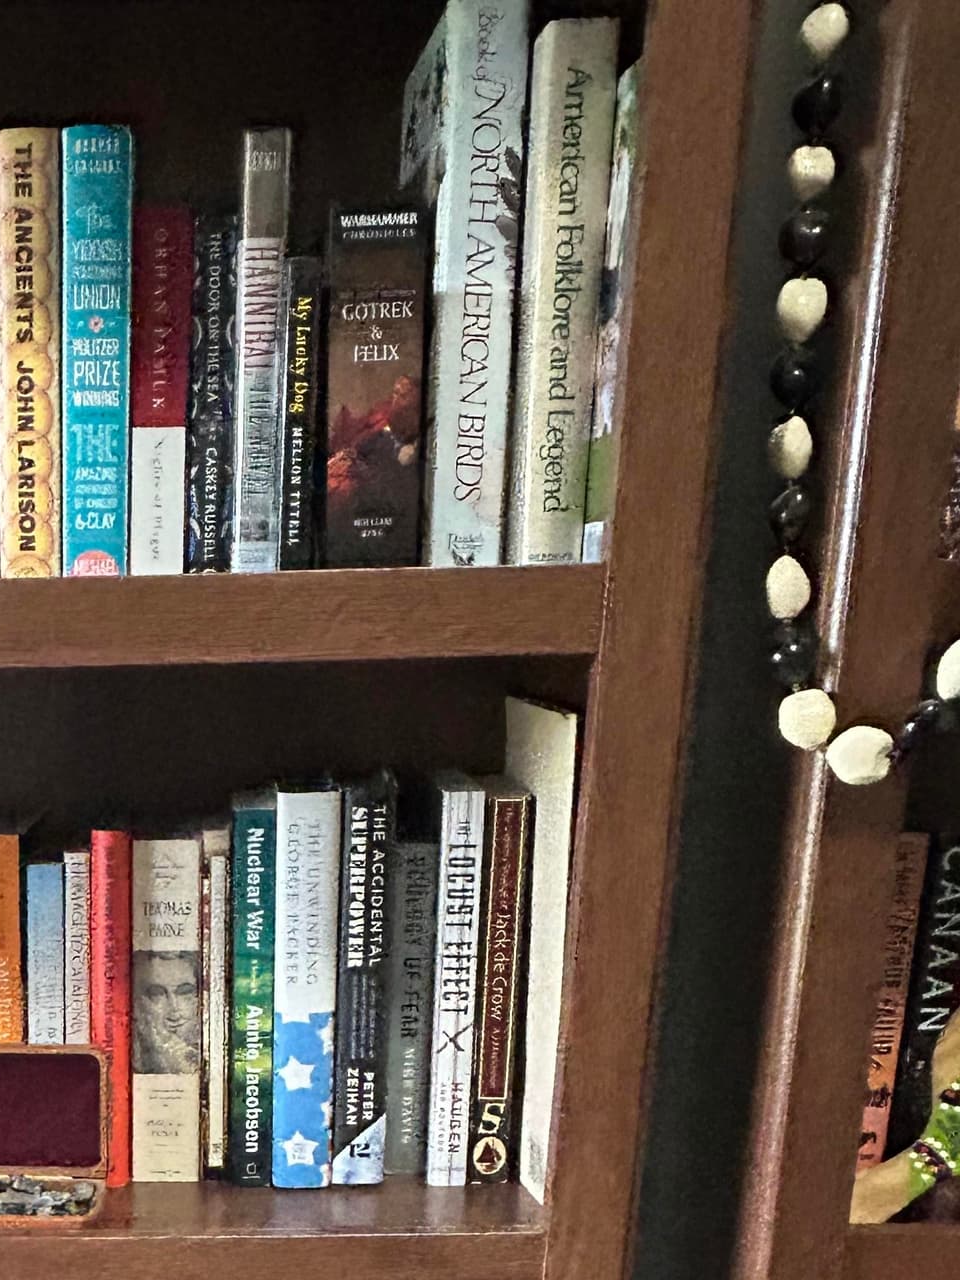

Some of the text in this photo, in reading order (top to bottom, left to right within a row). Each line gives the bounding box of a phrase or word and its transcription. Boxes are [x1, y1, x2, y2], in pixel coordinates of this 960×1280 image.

[468, 84, 504, 225] NORTH
[340, 213, 418, 227] WARHAMMER
[73, 284, 121, 309] UNION
[207, 233, 222, 402] THE DOOR ON THE SEA
[243, 246, 279, 372] HANNIBAL
[342, 301, 413, 320] GOTREK
[458, 233, 496, 408] AMERICAN
[540, 67, 594, 513] American Folklore and Legend
[14, 143, 39, 553] THE ANCIENTS JOHN LARISON
[290, 297, 313, 413] My Lucky Dog
[354, 344, 400, 362] FELIX
[371, 325, 382, 340] &
[73, 360, 121, 387] PRIZE
[70, 423, 119, 462] THE
[452, 413, 484, 503] BIRDS
[204, 448, 219, 561] CASKEY RUSSELL
[288, 491, 302, 547] TYTELL
[143, 900, 192, 915] THOMAS
[246, 827, 265, 950] Nuclear War
[285, 823, 302, 985] GEORGE PACKER
[303, 822, 320, 986] THE UNWINDING
[346, 806, 369, 969] SUPERPOWER
[368, 805, 387, 968] THE ACCIDENTAL
[440, 842, 478, 1016] LOCUST EFFECT
[493, 911, 512, 949] Jack
[493, 952, 510, 974] de
[400, 989, 421, 1039] FEAR
[490, 976, 509, 1020] Crow
[244, 1005, 263, 1153] Annie Jacobson
[345, 1068, 360, 1126] ZEIHAN
[361, 1072, 376, 1121] PETER
[446, 1081, 464, 1154] HAUGEN
